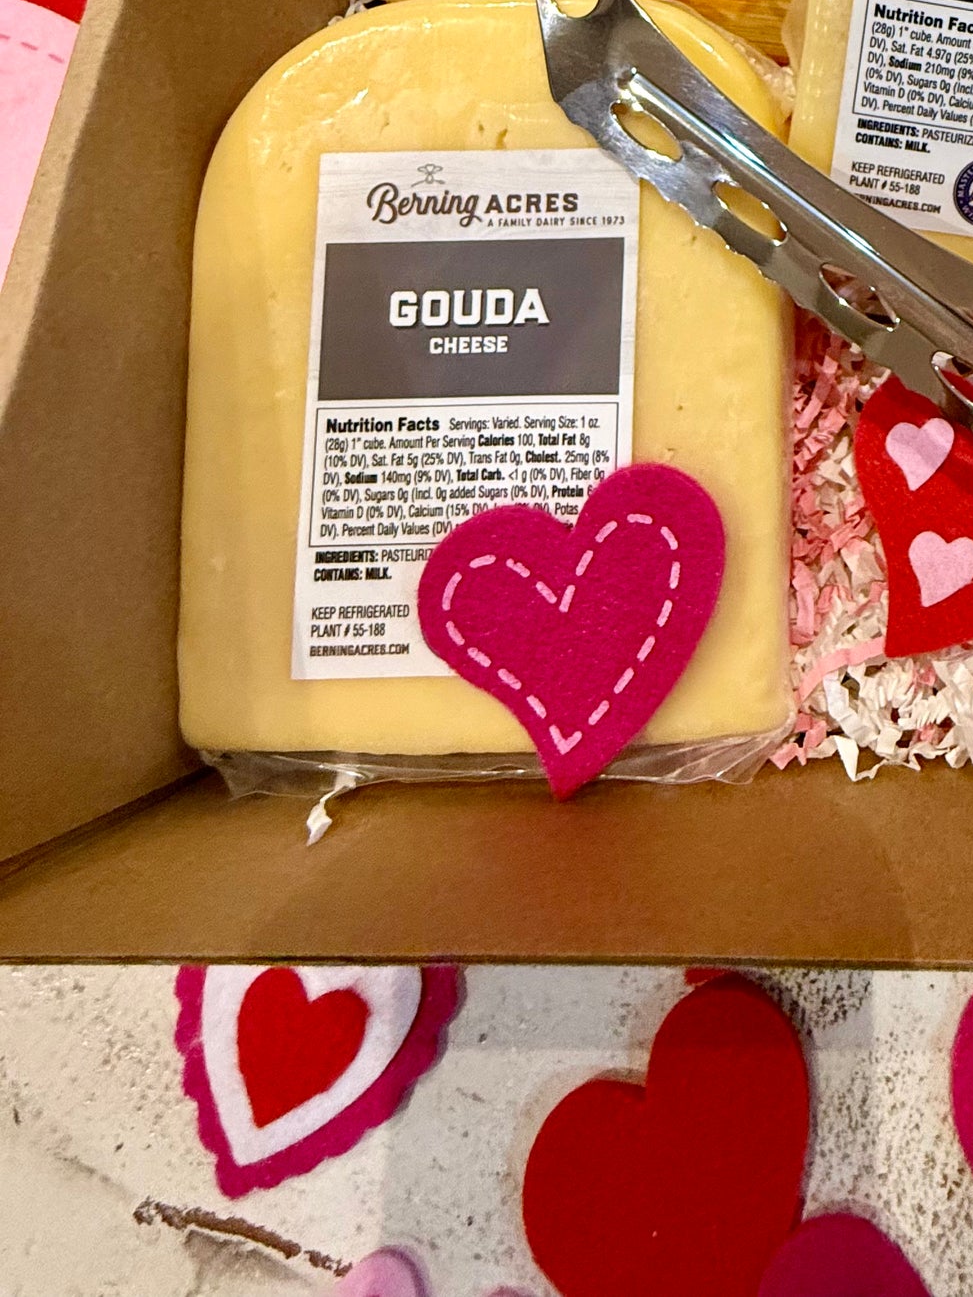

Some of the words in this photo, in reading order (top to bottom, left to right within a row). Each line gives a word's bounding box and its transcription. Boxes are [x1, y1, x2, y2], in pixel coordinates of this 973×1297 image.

[873, 3, 944, 29] Nutrition
[857, 117, 920, 138] INGREDIENTS:
[851, 161, 876, 174] KEEP
[876, 164, 946, 185] REFRIGERATED
[848, 174, 881, 189] PLANT
[888, 180, 921, 196] 55-188
[367, 182, 483, 227] Berning
[485, 193, 579, 214] ACRES
[487, 218, 494, 227] A
[498, 218, 532, 227] FAMILY
[535, 217, 565, 227] DAIRY
[569, 216, 597, 226] SINCE
[602, 215, 625, 226] 1973
[389, 288, 550, 328] GOUDA
[429, 336, 509, 355] CHEESE
[325, 416, 393, 434] Nutrition
[397, 416, 440, 432] Facts
[449, 417, 489, 433] Servings:
[492, 416, 519, 430] Varied.
[524, 415, 556, 432] Serving
[558, 415, 576, 429] Size:
[581, 415, 585, 428] 1
[588, 418, 599, 429] oz.
[311, 606, 337, 621] KEEP
[338, 604, 410, 620] REFRIGERATED
[310, 623, 343, 638] PLANT
[343, 623, 351, 637] #
[352, 622, 386, 638] 55-188
